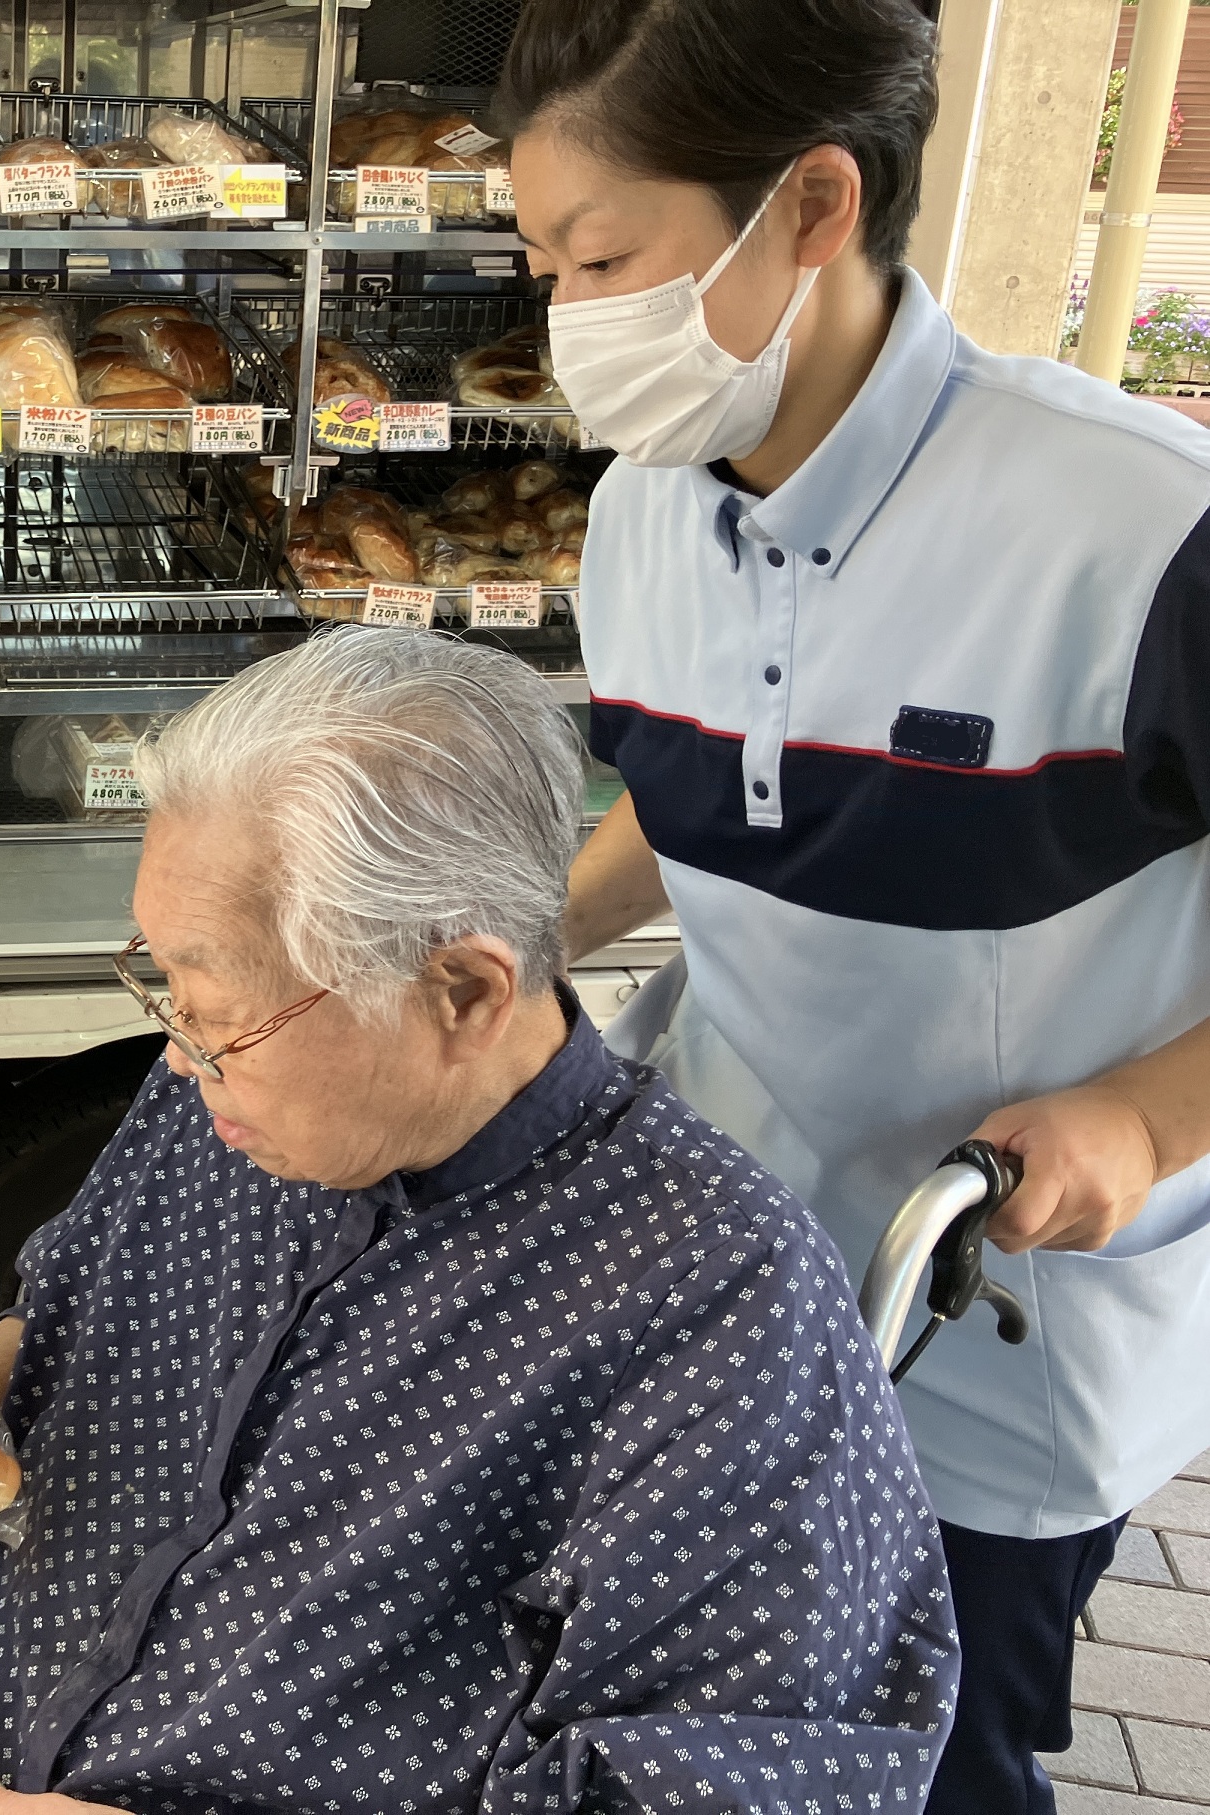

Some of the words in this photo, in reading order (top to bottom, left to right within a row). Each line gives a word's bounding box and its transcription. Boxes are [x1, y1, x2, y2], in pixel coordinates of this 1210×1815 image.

[3, 164, 72, 181] 塩バターフランス
[157, 166, 205, 179] さつまいもと
[26, 407, 87, 422] 米粉パン
[195, 408, 257, 421] 5種の豆パン
[324, 422, 371, 442] 新商品
